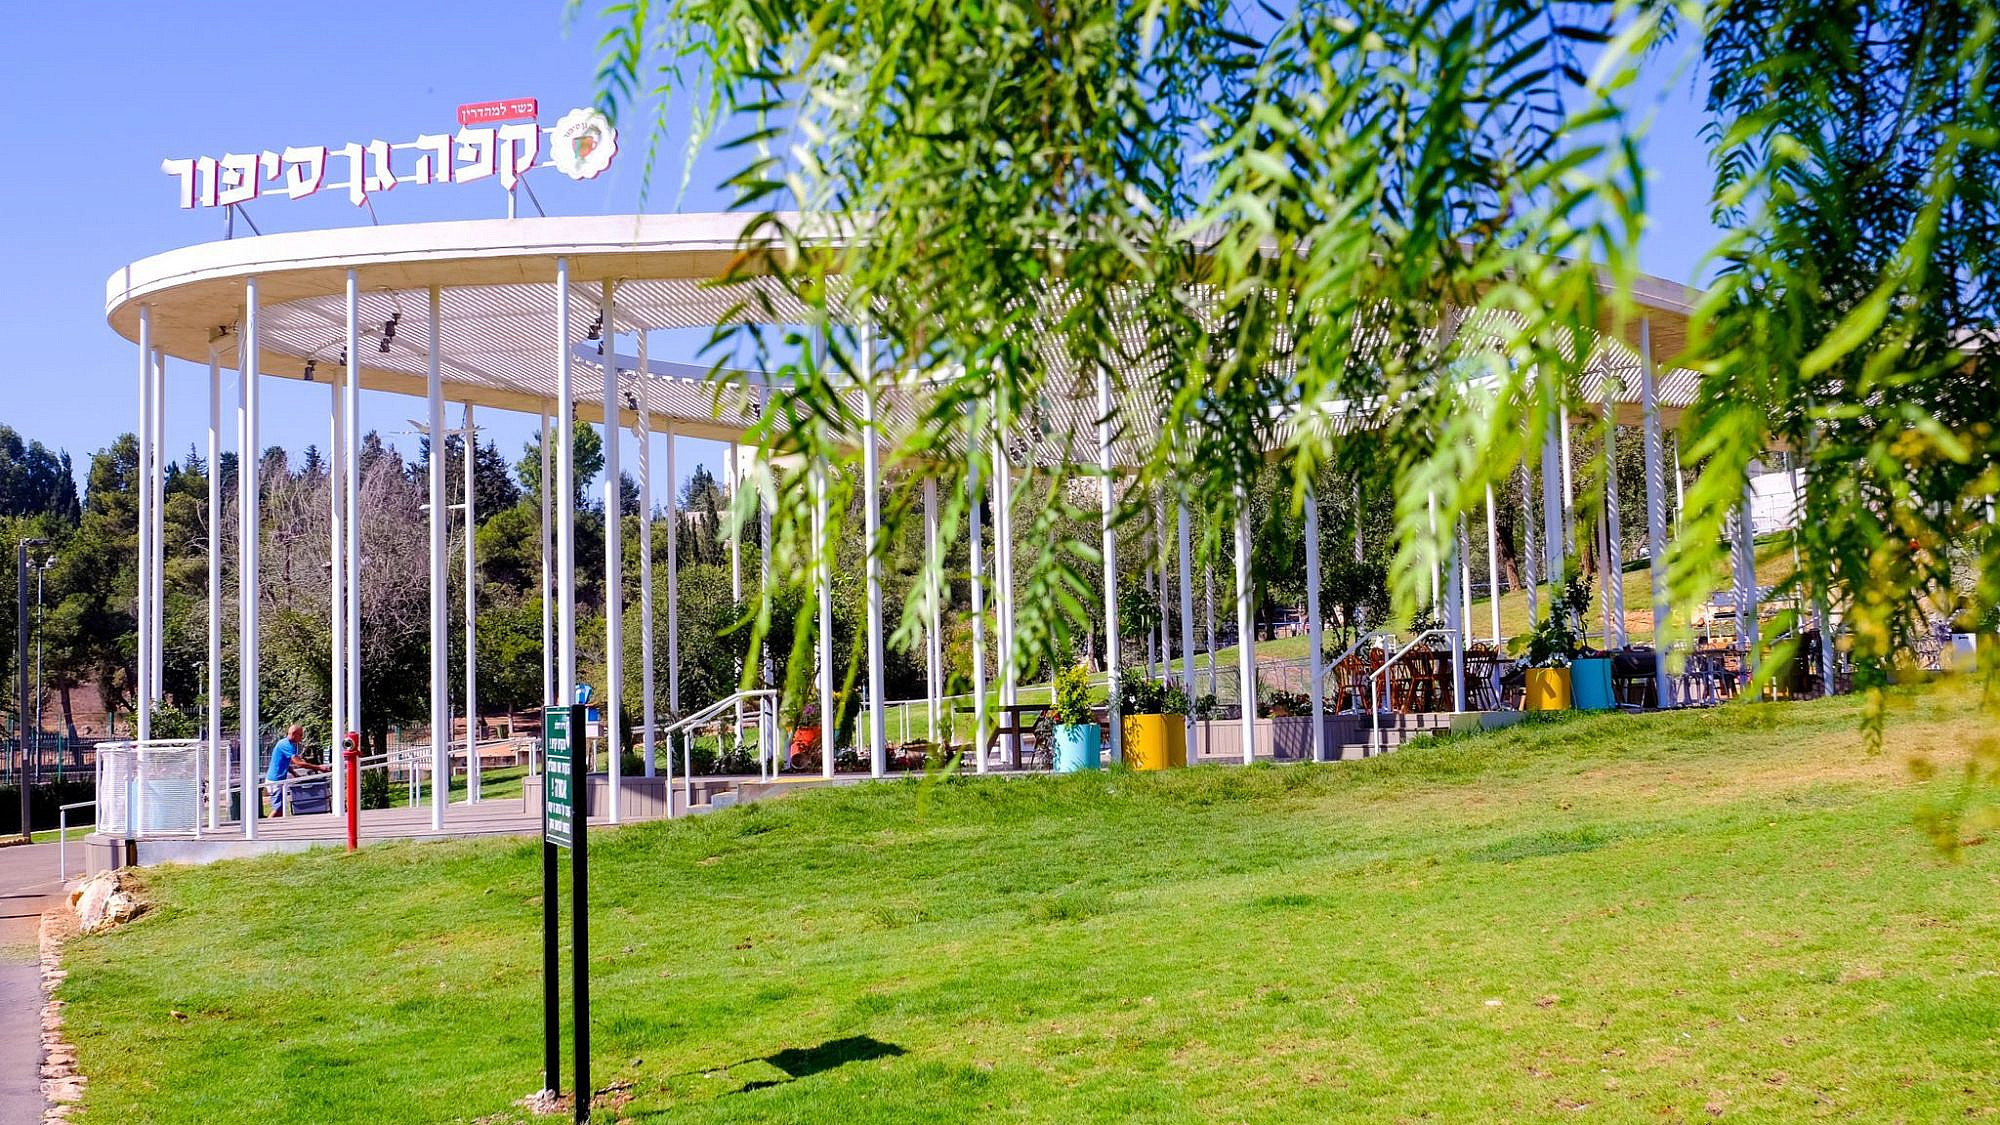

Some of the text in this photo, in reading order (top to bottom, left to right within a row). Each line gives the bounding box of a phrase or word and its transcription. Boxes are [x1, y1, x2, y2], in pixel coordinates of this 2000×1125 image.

[461, 102, 533, 122] כשר למהדרין
[160, 123, 539, 209] קפה גן סיפור
